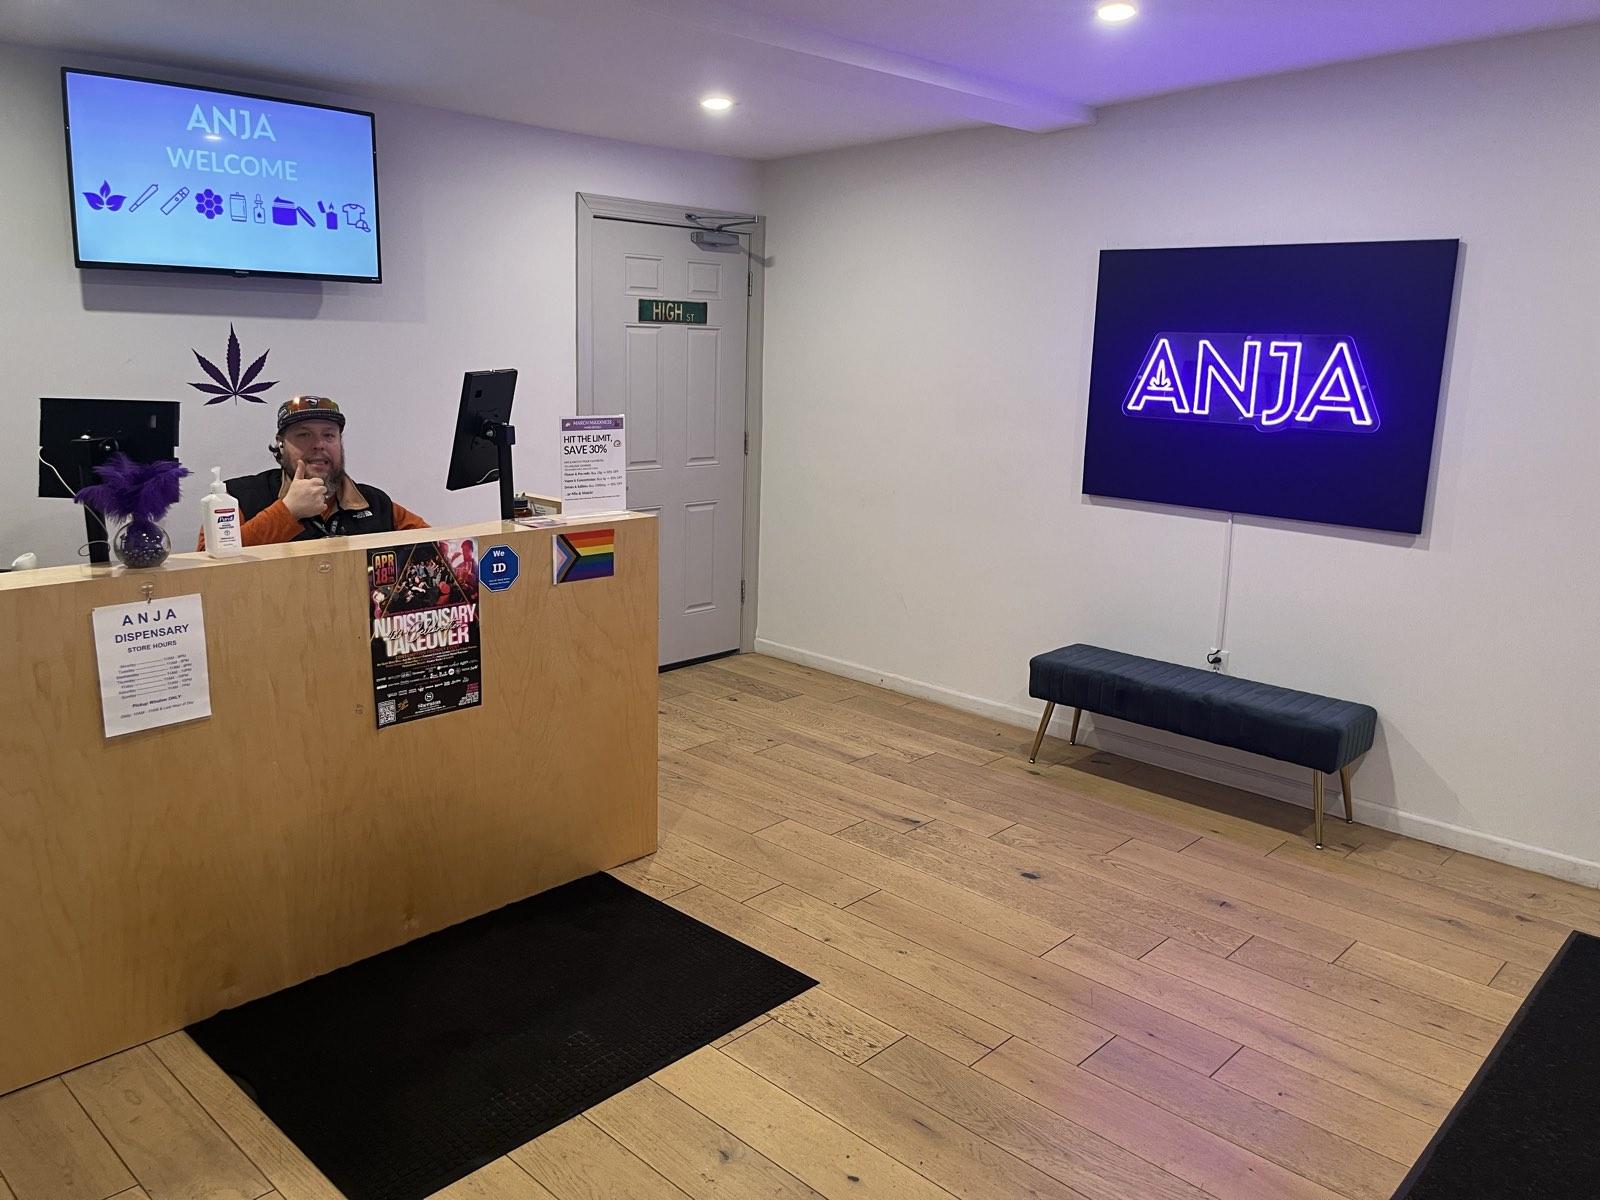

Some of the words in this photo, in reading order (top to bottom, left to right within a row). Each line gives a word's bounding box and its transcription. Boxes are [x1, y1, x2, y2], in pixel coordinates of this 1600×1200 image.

[186, 103, 276, 141] ANJA
[166, 146, 298, 181] WELCOME
[652, 302, 683, 321] HIGH
[686, 313, 695, 322] ST
[1126, 337, 1373, 426] ANJA
[577, 435, 591, 443] THE
[592, 434, 613, 443] LIMIT,
[564, 445, 588, 455] SAVE
[589, 444, 608, 454] 30%
[375, 553, 394, 569] APR
[493, 550, 505, 558] We
[492, 562, 506, 573] ID
[393, 604, 476, 633] DISPENSARY
[115, 624, 190, 643] DISPENSARY
[382, 624, 470, 657] TAKEOVER
[127, 645, 150, 653] STORE
[153, 640, 177, 650] HOURS
